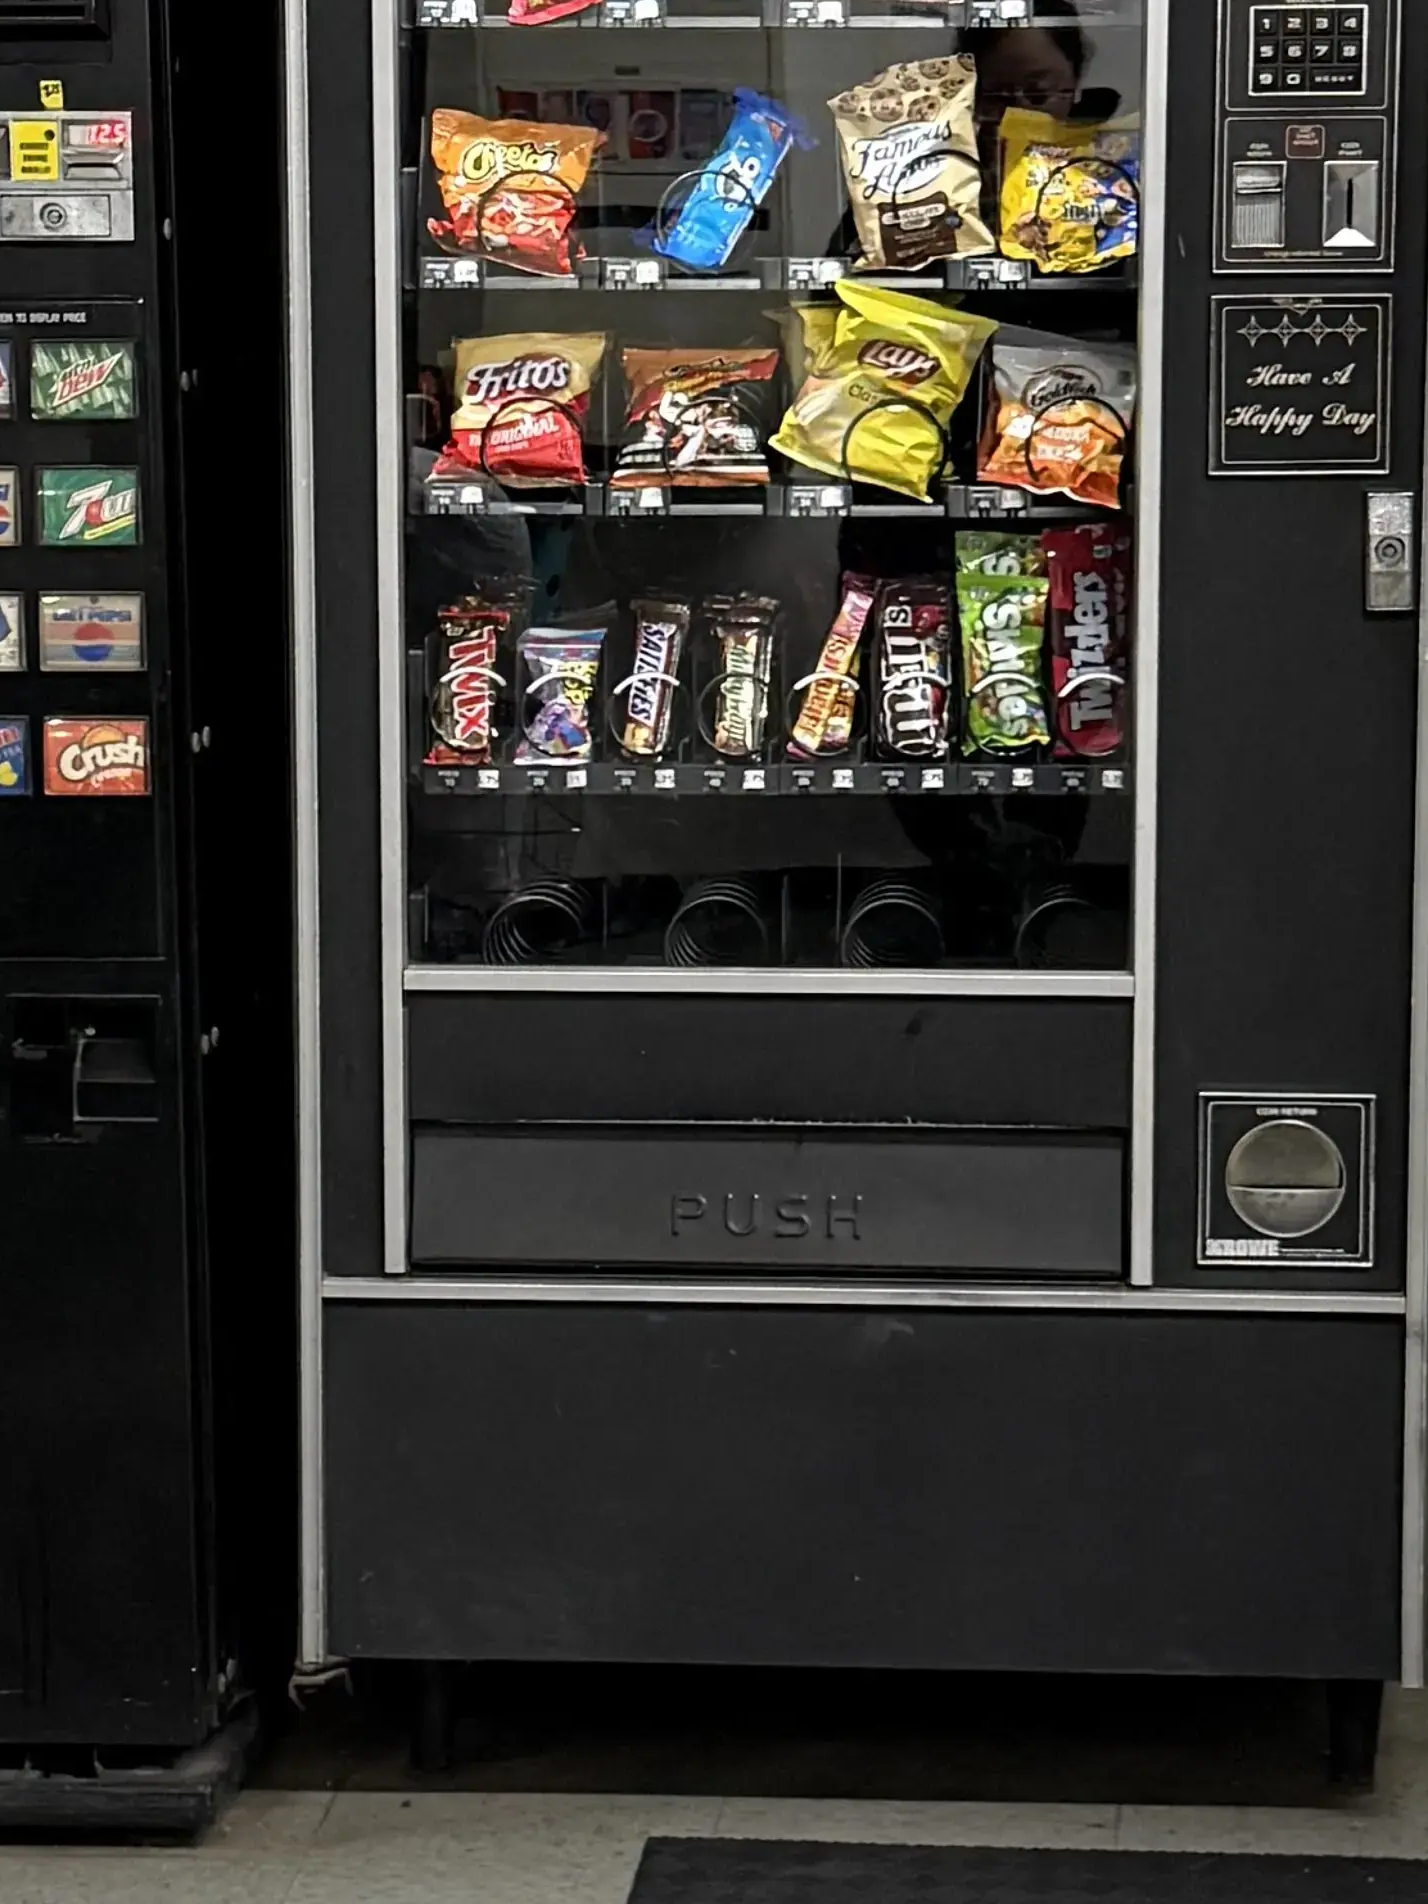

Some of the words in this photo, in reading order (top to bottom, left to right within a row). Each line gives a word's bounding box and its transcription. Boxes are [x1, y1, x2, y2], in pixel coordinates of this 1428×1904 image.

[1262, 18, 1271, 30] 1
[1287, 17, 1302, 29] 2
[1315, 17, 1329, 29] 3
[1344, 17, 1357, 28] 4
[1259, 45, 1274, 57] 5
[1287, 45, 1301, 57] 6
[1314, 45, 1329, 57] 7
[1343, 45, 1356, 57] 8
[1259, 73, 1273, 85] 9
[1286, 73, 1301, 85] 0
[850, 119, 952, 177] Famous
[462, 141, 559, 183] Cheetos
[467, 356, 571, 404] Fritos
[1246, 363, 1312, 387] Have
[1322, 362, 1356, 385] A
[1031, 379, 1099, 407] Goldfish
[1225, 403, 1314, 436] Happy
[1322, 402, 1376, 435] Day
[60, 735, 145, 781] Crush
[669, 1191, 864, 1241] PUSH
